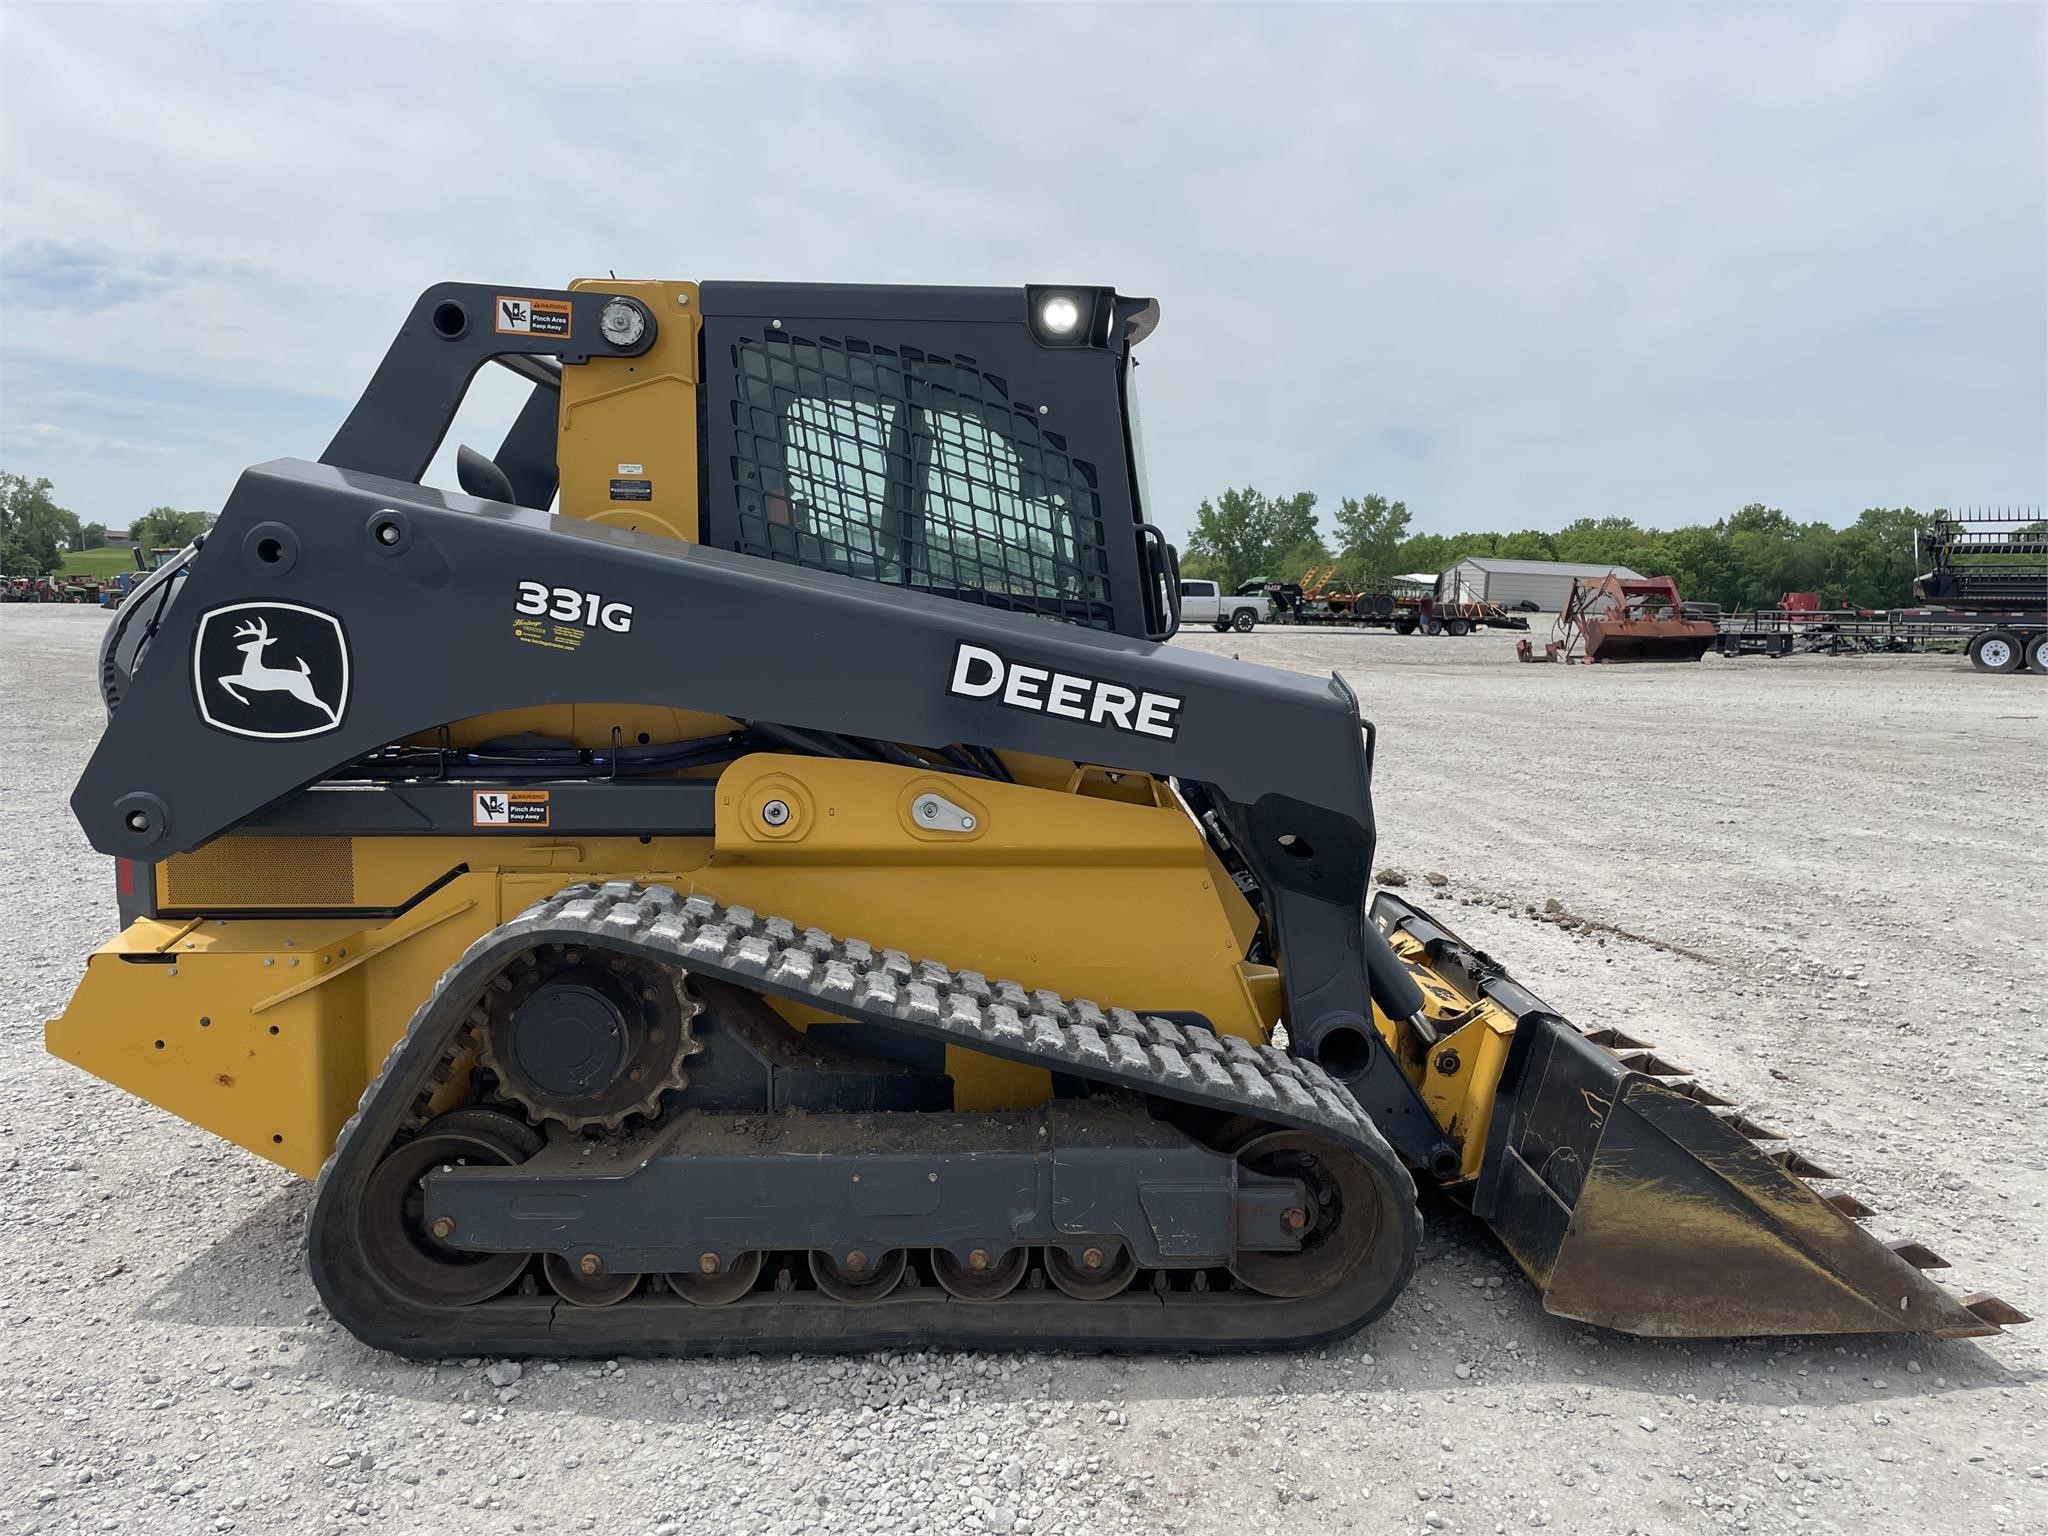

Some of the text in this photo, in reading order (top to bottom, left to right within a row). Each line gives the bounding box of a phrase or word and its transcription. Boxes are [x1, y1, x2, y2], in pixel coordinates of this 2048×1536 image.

[532, 315, 567, 324] Pinch Area
[540, 302, 567, 311] WARNING
[516, 581, 633, 632] 331G
[951, 643, 1181, 738] DEERE
